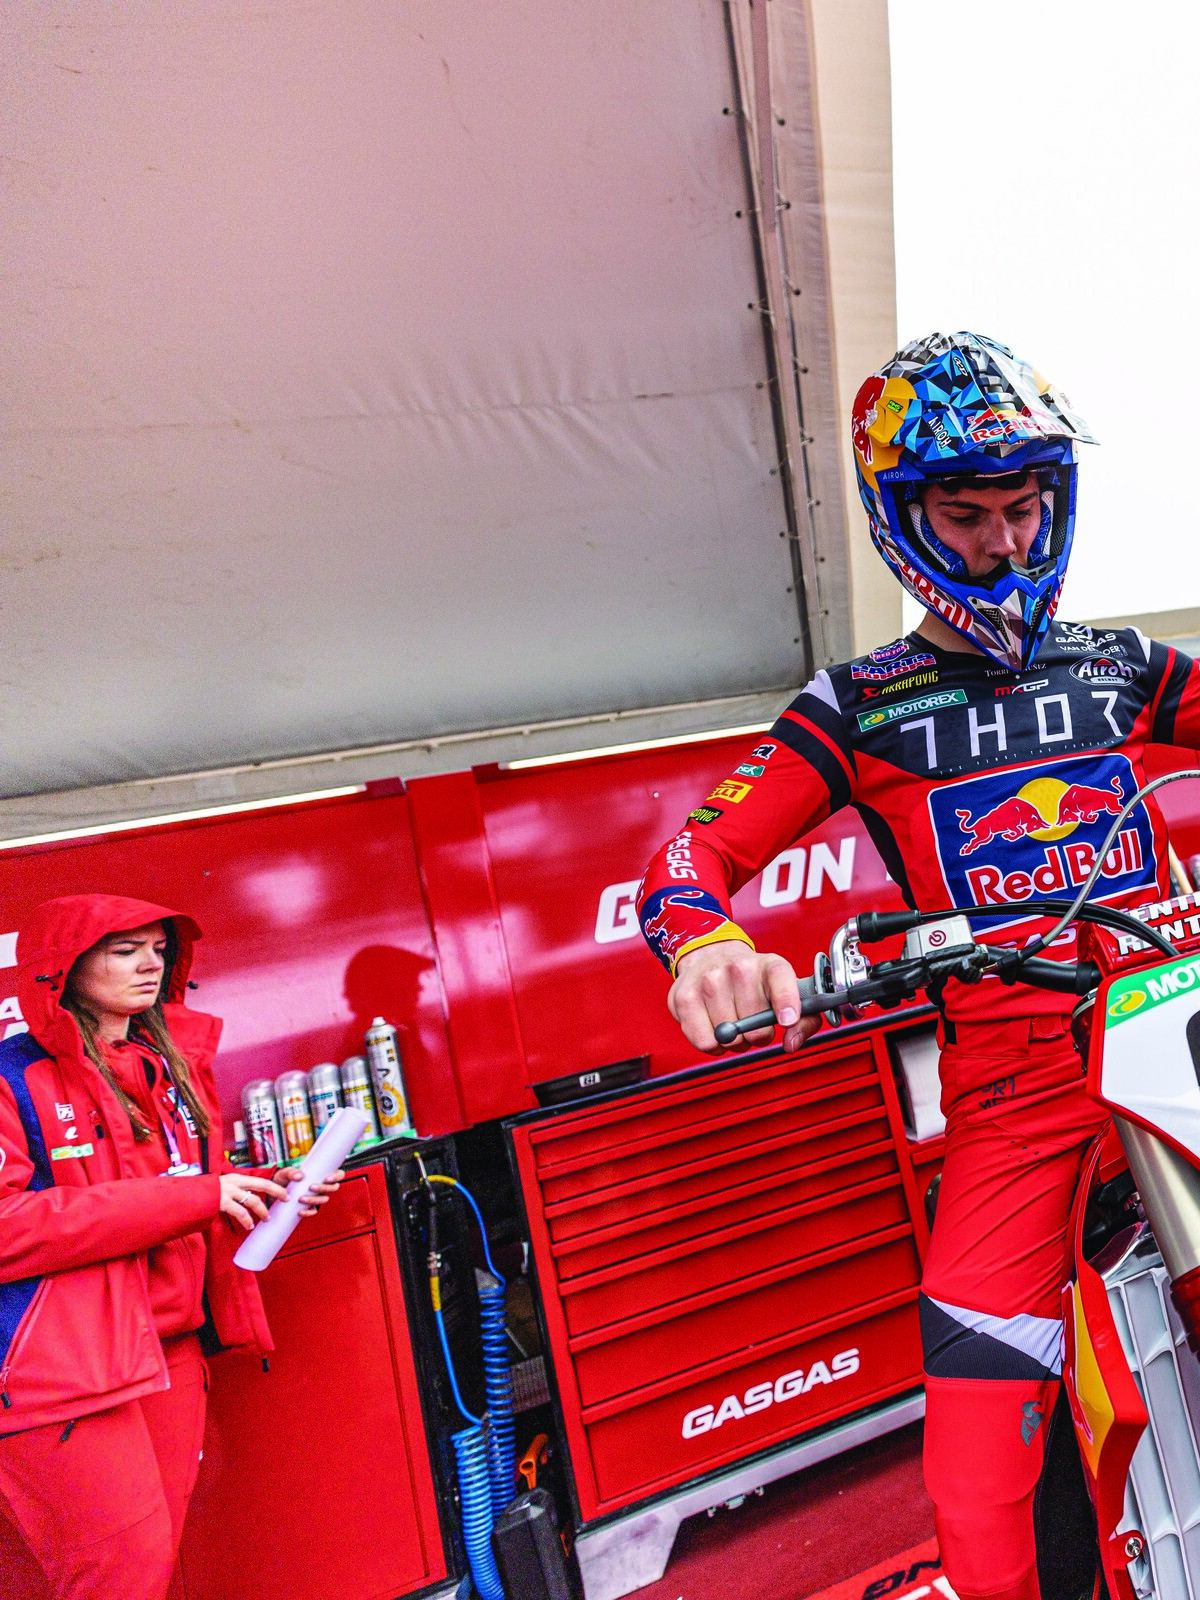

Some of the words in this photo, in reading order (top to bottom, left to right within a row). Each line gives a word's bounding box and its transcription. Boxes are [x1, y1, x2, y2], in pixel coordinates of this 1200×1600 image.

[851, 652, 935, 675] PARTS
[1078, 660, 1134, 678] Airoh
[888, 692, 959, 718] MOTOREX
[965, 845, 1066, 906] Red
[1063, 828, 1144, 889] Bull
[681, 1347, 860, 1440] GASGAS
